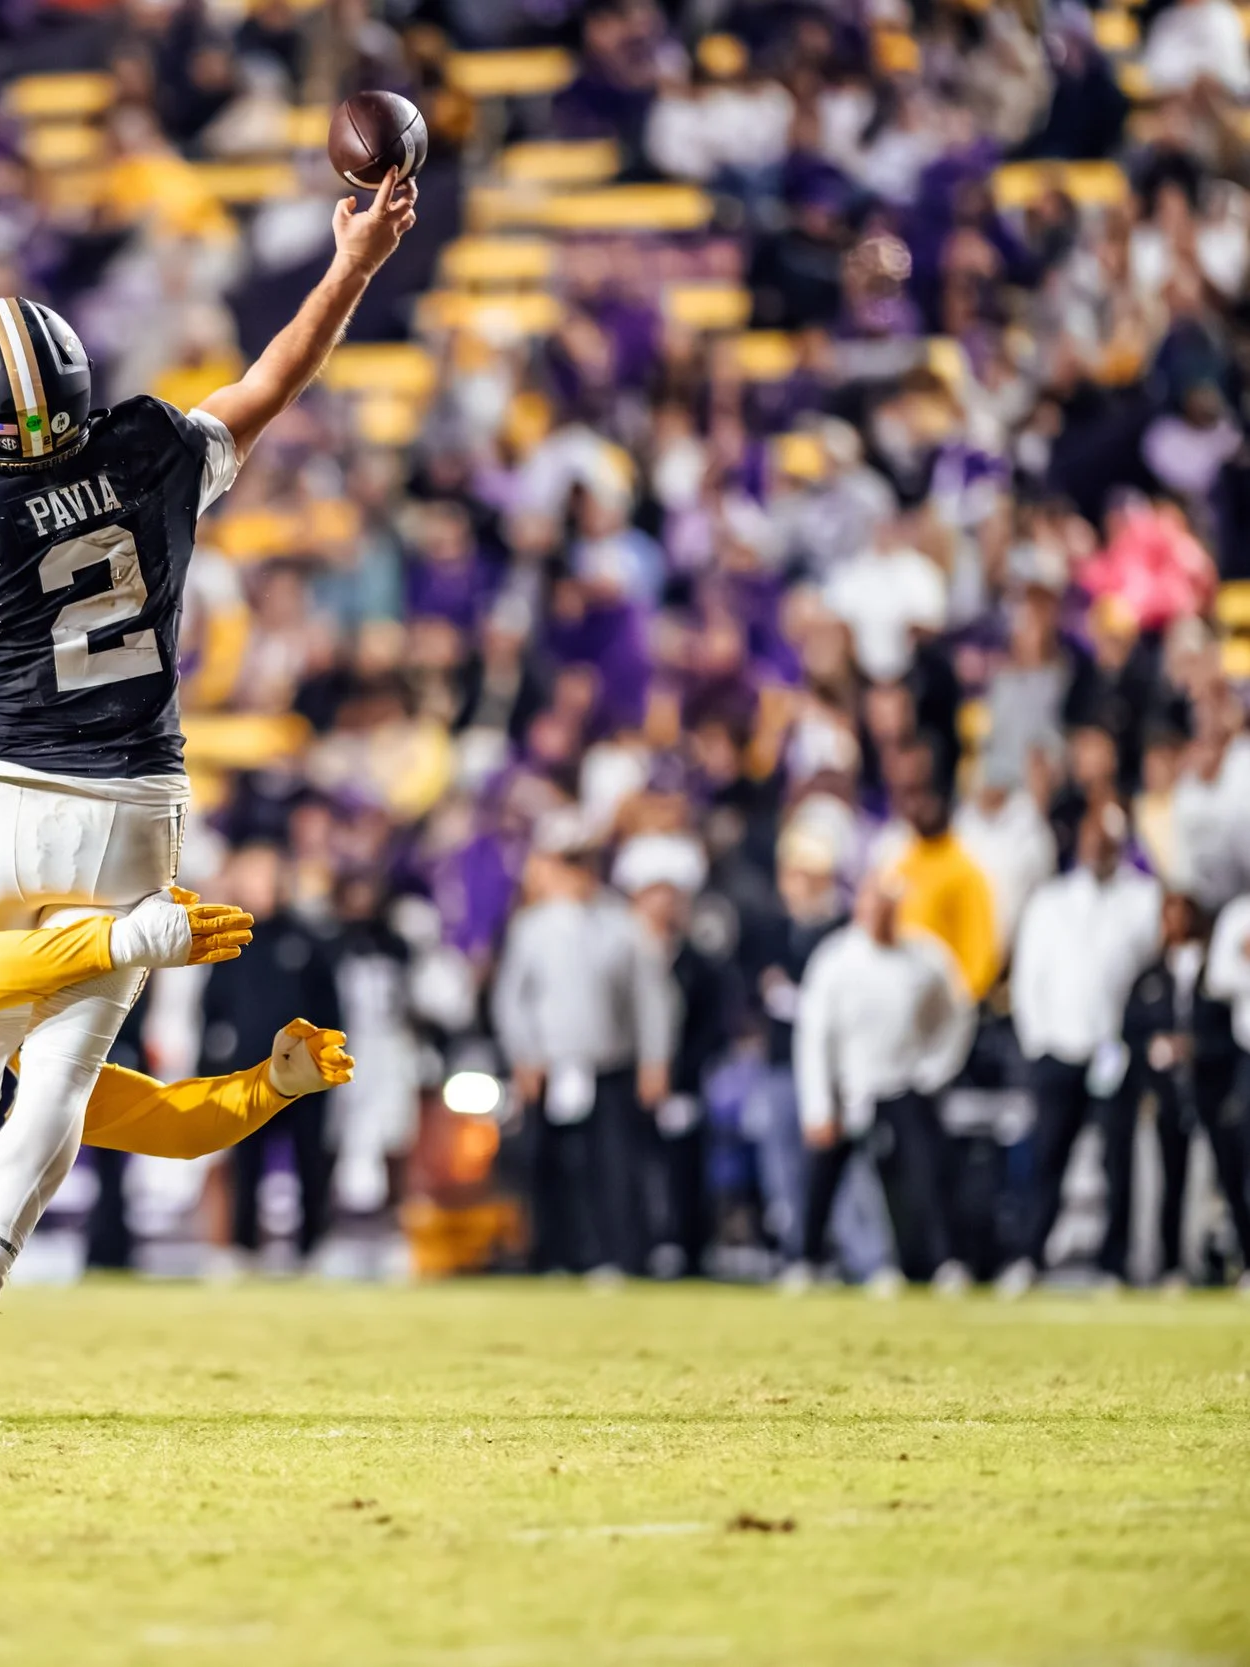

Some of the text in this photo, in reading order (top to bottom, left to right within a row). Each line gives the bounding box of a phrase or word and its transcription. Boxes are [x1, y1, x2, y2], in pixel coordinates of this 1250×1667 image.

[1, 437, 17, 451] SEC
[43, 435, 51, 446] 2
[25, 474, 122, 537] PAVIA
[38, 523, 164, 693] 2
